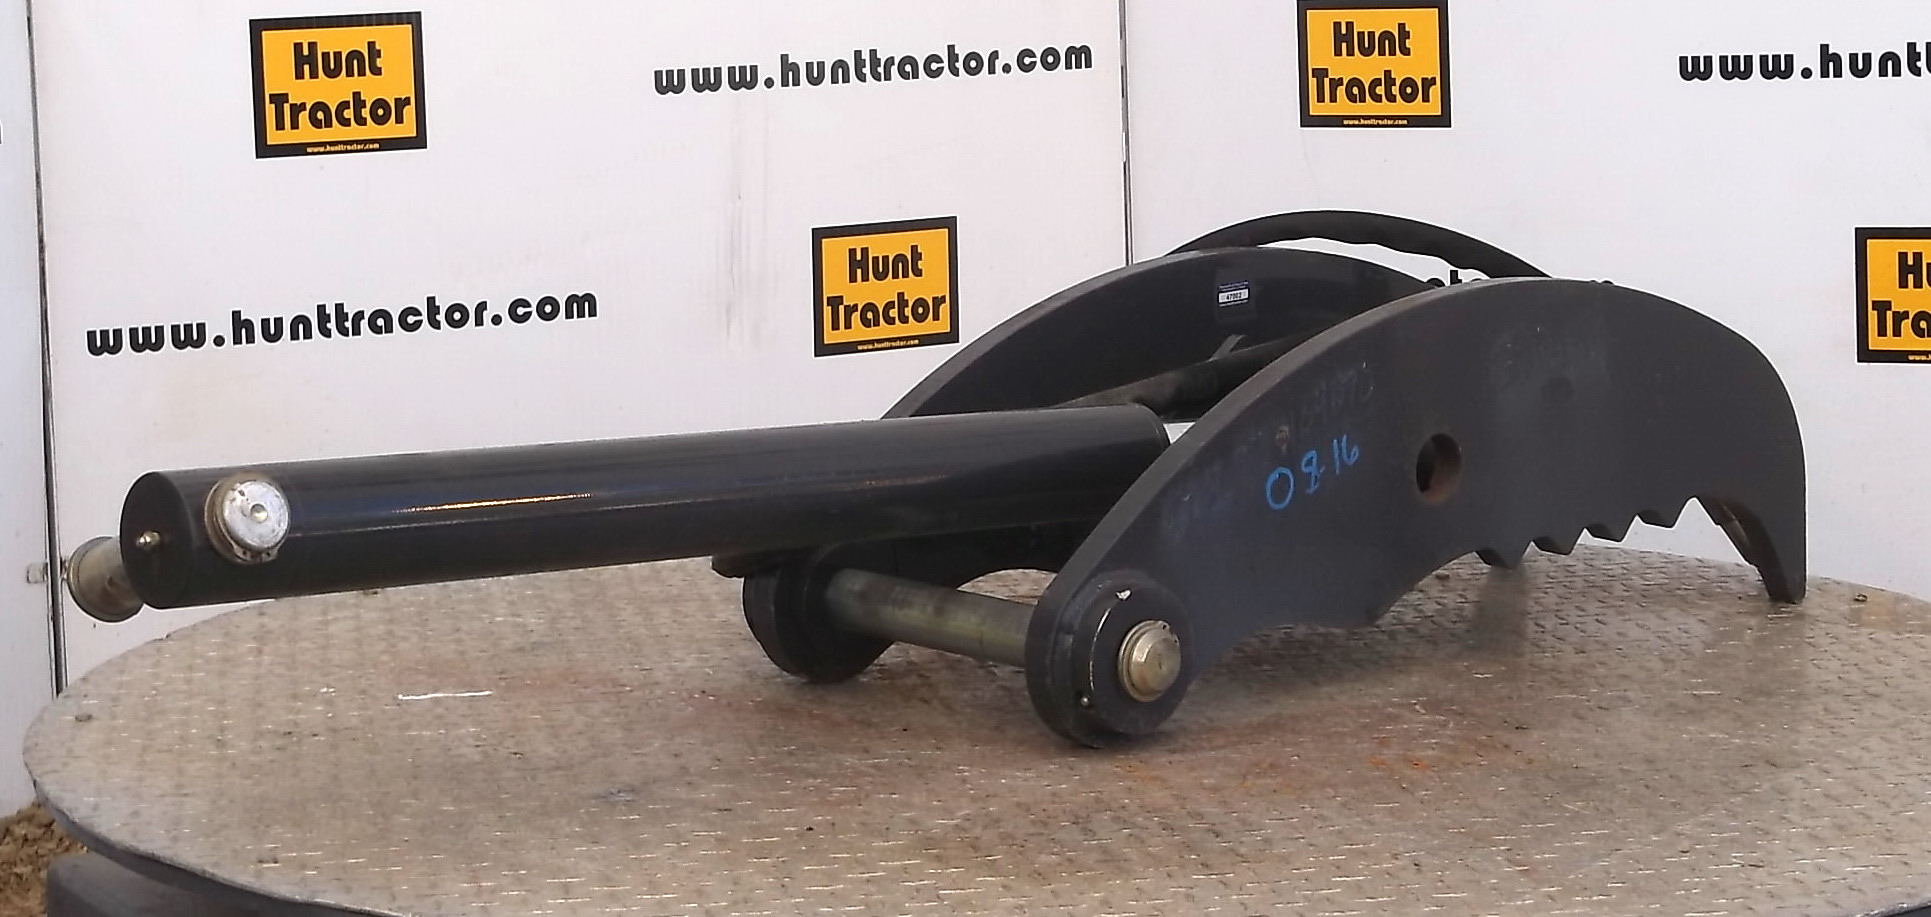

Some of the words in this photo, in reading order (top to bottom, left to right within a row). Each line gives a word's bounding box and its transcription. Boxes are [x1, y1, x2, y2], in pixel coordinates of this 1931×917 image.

[1333, 21, 1411, 57] Hunt
[293, 40, 383, 80] Hunt
[654, 44, 1093, 96] www.hunttractor.com
[1312, 67, 1437, 103] Tractor
[269, 91, 411, 131] Tractor
[848, 244, 923, 284] Hunt
[1898, 251, 1931, 289] H
[86, 292, 598, 357] www.hunttractor.com
[827, 291, 946, 332] Tractor
